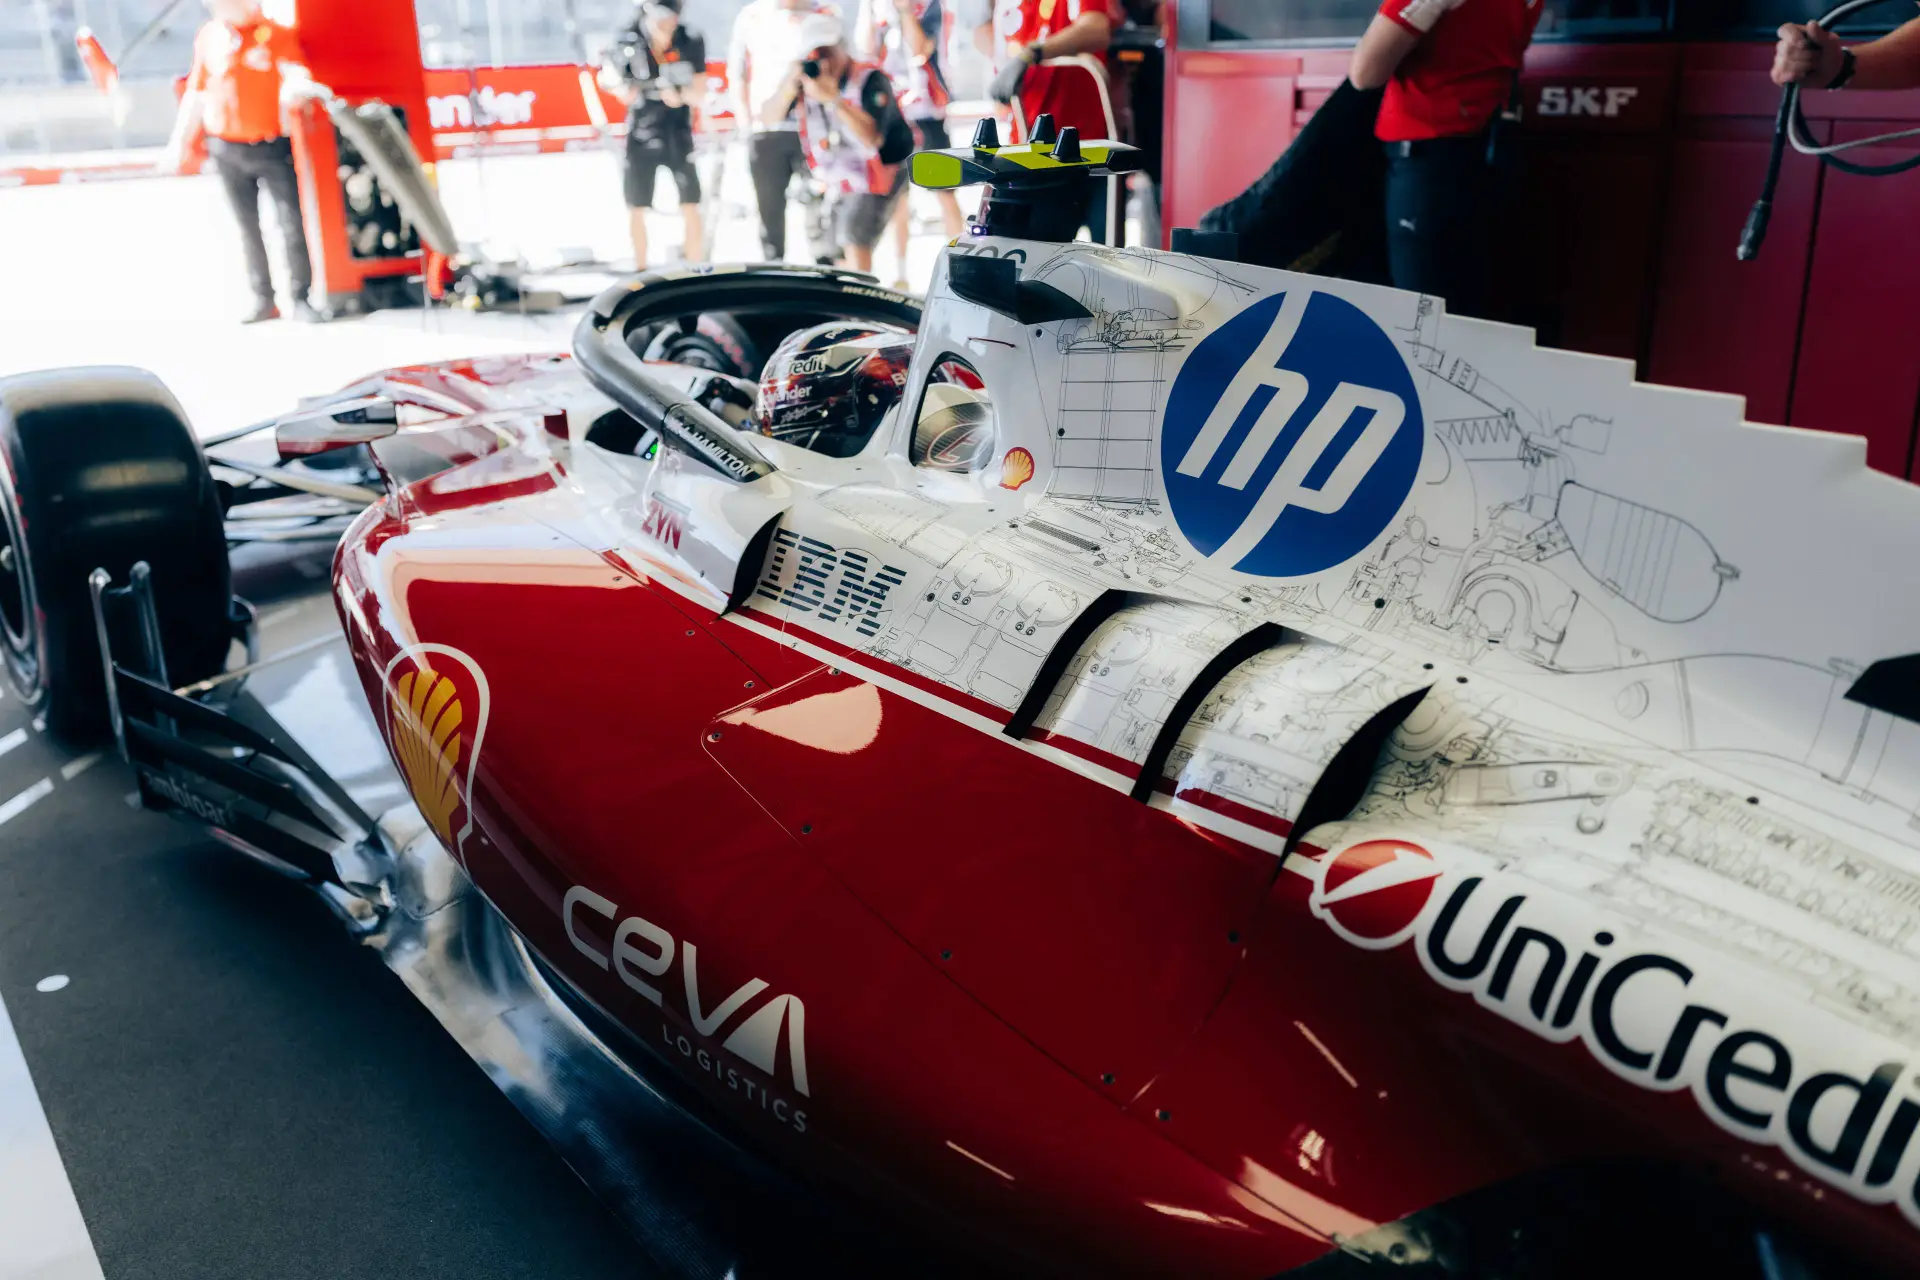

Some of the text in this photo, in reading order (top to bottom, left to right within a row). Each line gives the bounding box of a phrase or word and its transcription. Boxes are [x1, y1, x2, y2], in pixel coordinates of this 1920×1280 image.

[1538, 86, 1638, 116] SKF
[692, 432, 753, 477] HAMILTON
[1175, 290, 1406, 568] hp
[641, 500, 682, 550] ZYN
[756, 528, 907, 637] IBM
[662, 1023, 807, 1133] LOGISTICS
[1427, 877, 1920, 1212] UniCredi
